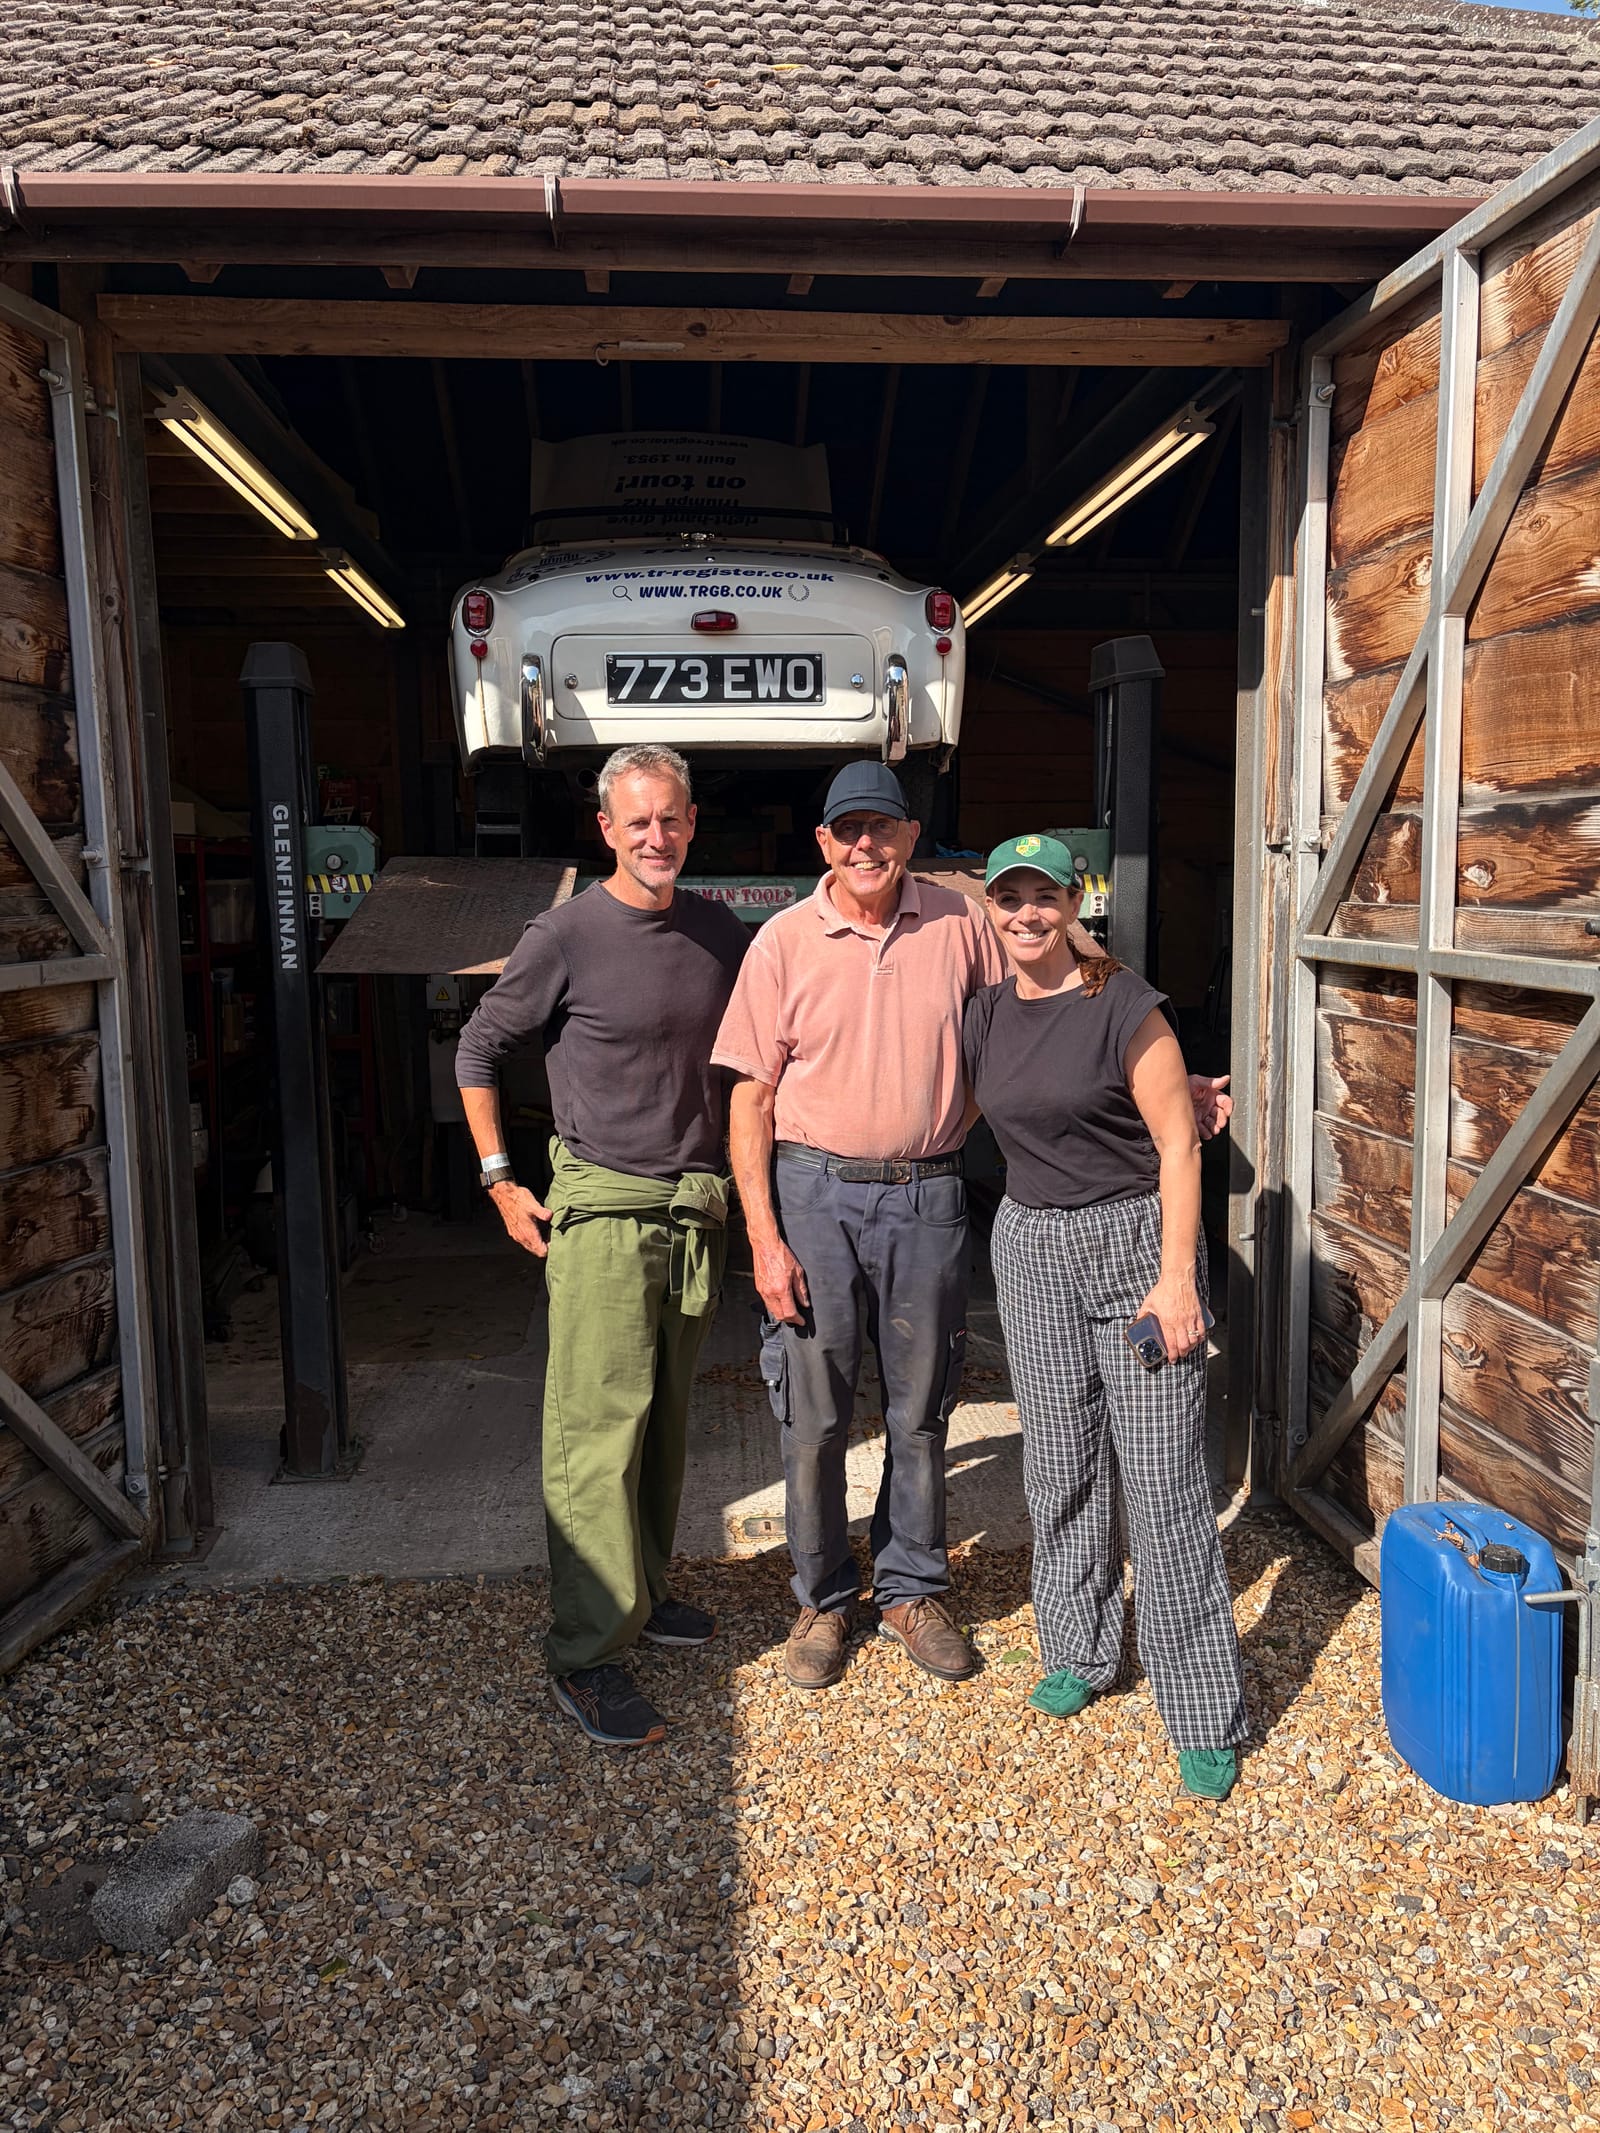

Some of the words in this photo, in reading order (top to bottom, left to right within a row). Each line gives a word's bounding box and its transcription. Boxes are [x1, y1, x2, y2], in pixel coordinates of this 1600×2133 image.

[623, 454, 671, 465] 1953.
[675, 455, 692, 464] in
[696, 455, 737, 466] Built
[614, 475, 695, 493] tour!
[706, 476, 747, 489] on
[607, 514, 656, 526] drive
[585, 567, 834, 583] www.tr-register.co.uk
[639, 585, 783, 599] WWW.TRGB.CO.UK
[616, 658, 709, 700] 773
[723, 658, 815, 699] EWO
[272, 804, 298, 969] GLENFINNAN
